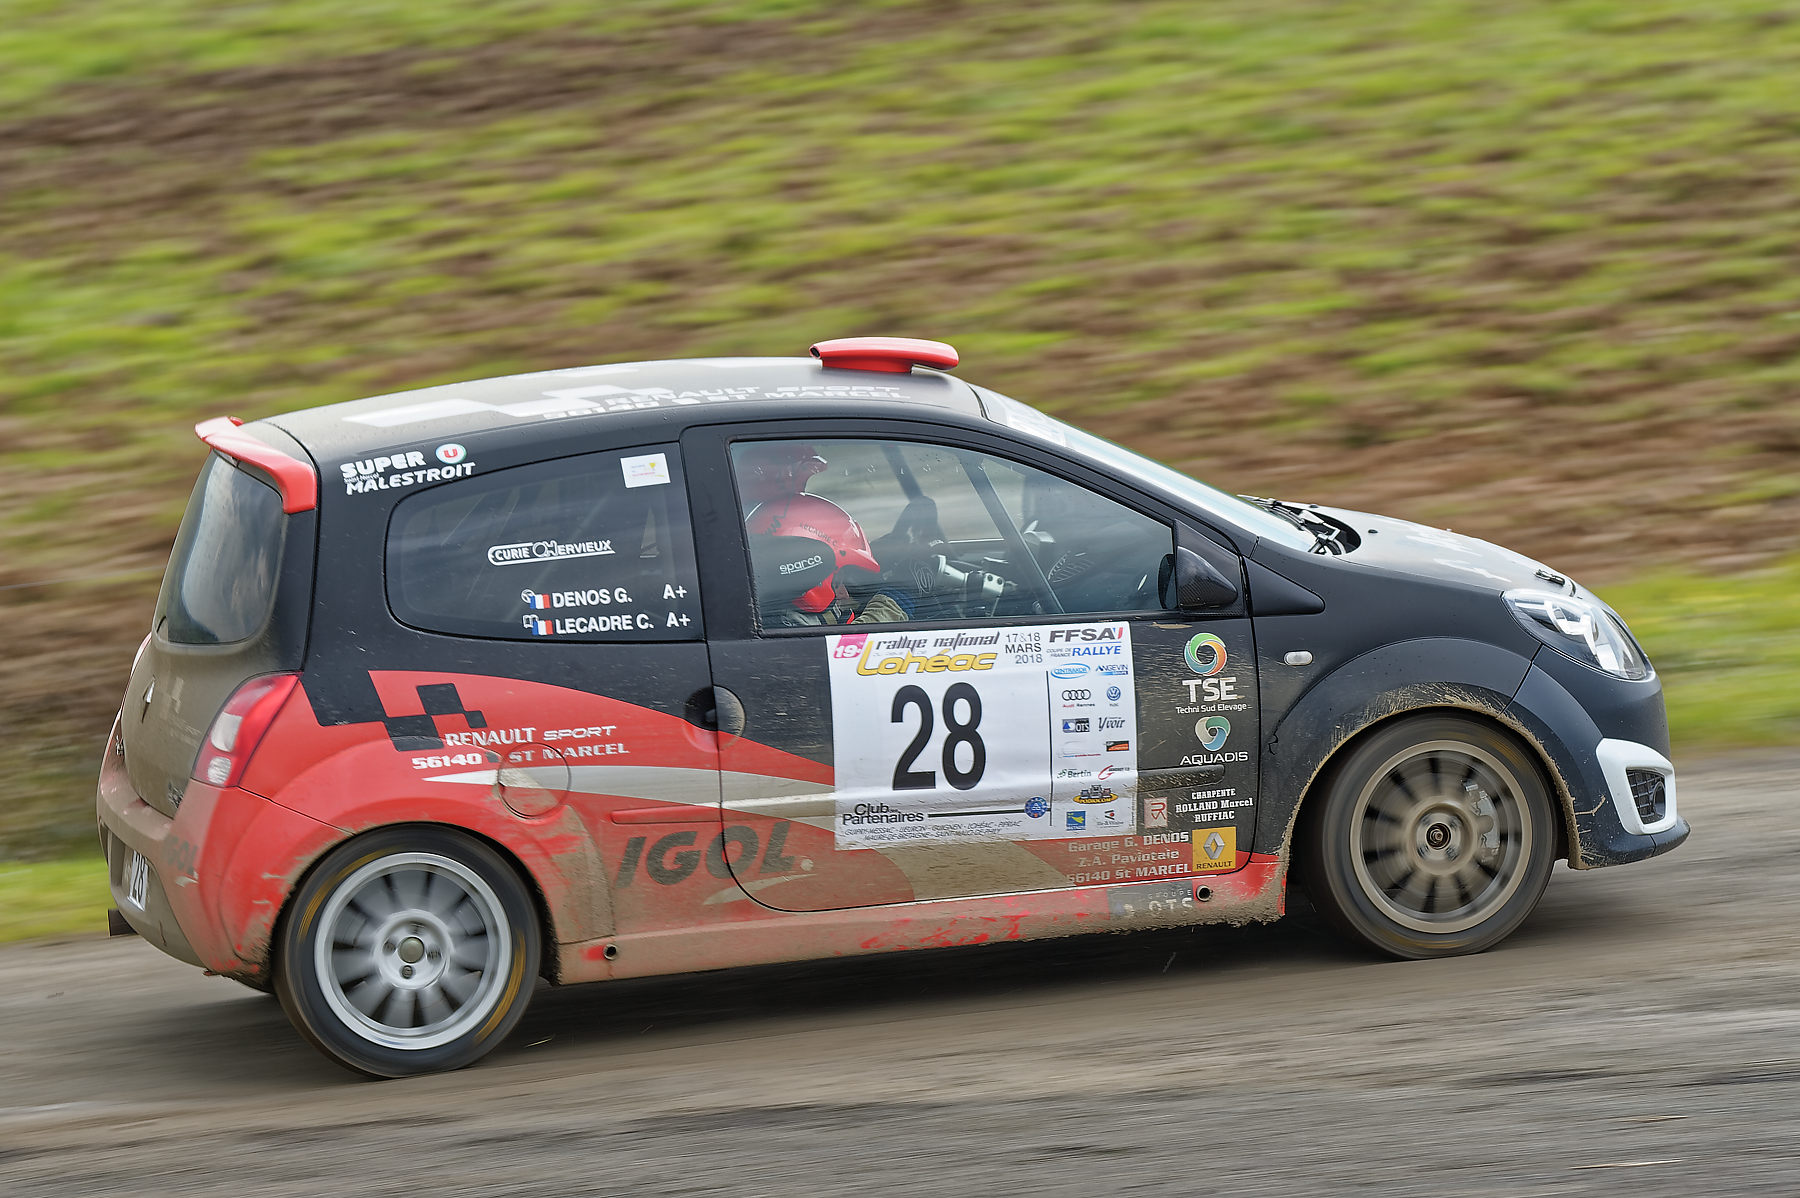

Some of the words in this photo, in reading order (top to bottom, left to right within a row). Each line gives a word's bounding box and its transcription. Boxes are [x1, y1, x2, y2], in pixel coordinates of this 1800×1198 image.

[340, 451, 427, 479] SUPER
[346, 461, 476, 495] MALESTROIT
[779, 555, 822, 575] sparco
[552, 591, 611, 609] DENOS
[614, 588, 633, 604] G.
[662, 584, 688, 600] A+
[555, 613, 633, 635] LECADRE
[636, 613, 655, 629] C.
[666, 611, 691, 628] A+
[876, 636, 927, 652] rallye
[933, 631, 1000, 650] national
[1049, 627, 1118, 643] FFSA
[857, 640, 998, 676] Lohéac
[1005, 643, 1042, 654] MARS
[1072, 645, 1121, 657] RALLYE
[1015, 654, 1043, 664] 2018
[1182, 677, 1238, 703] TSE
[1175, 705, 1199, 714] Techni
[1201, 704, 1216, 712] Sud
[1217, 702, 1247, 712] Elevage
[444, 727, 536, 746] RENAULT
[543, 725, 616, 741] SPORT
[891, 681, 986, 791] 28
[1076, 723, 1089, 733] OTS
[411, 752, 482, 769] 56140
[508, 750, 535, 763] ST
[542, 743, 630, 760] MARCEL
[1180, 752, 1248, 766] AQUADIS
[1191, 789, 1236, 800] CHARPENTE
[854, 803, 889, 817] Club
[1175, 801, 1218, 813] ROLLAND
[1220, 798, 1253, 809] Marcel
[842, 811, 924, 826] Partenaires
[1194, 811, 1235, 823] RUFFIAC
[1068, 840, 1120, 853] Garage
[1123, 836, 1138, 848] G.
[1143, 831, 1189, 846] DENOS
[615, 821, 795, 889] IGOL
[1111, 850, 1179, 865] Paviotaie
[1068, 870, 1111, 884] 56140
[1115, 869, 1131, 879] St
[1136, 863, 1191, 877] MARCEL
[1196, 861, 1232, 870] RENAULT
[128, 851, 148, 904] 28
